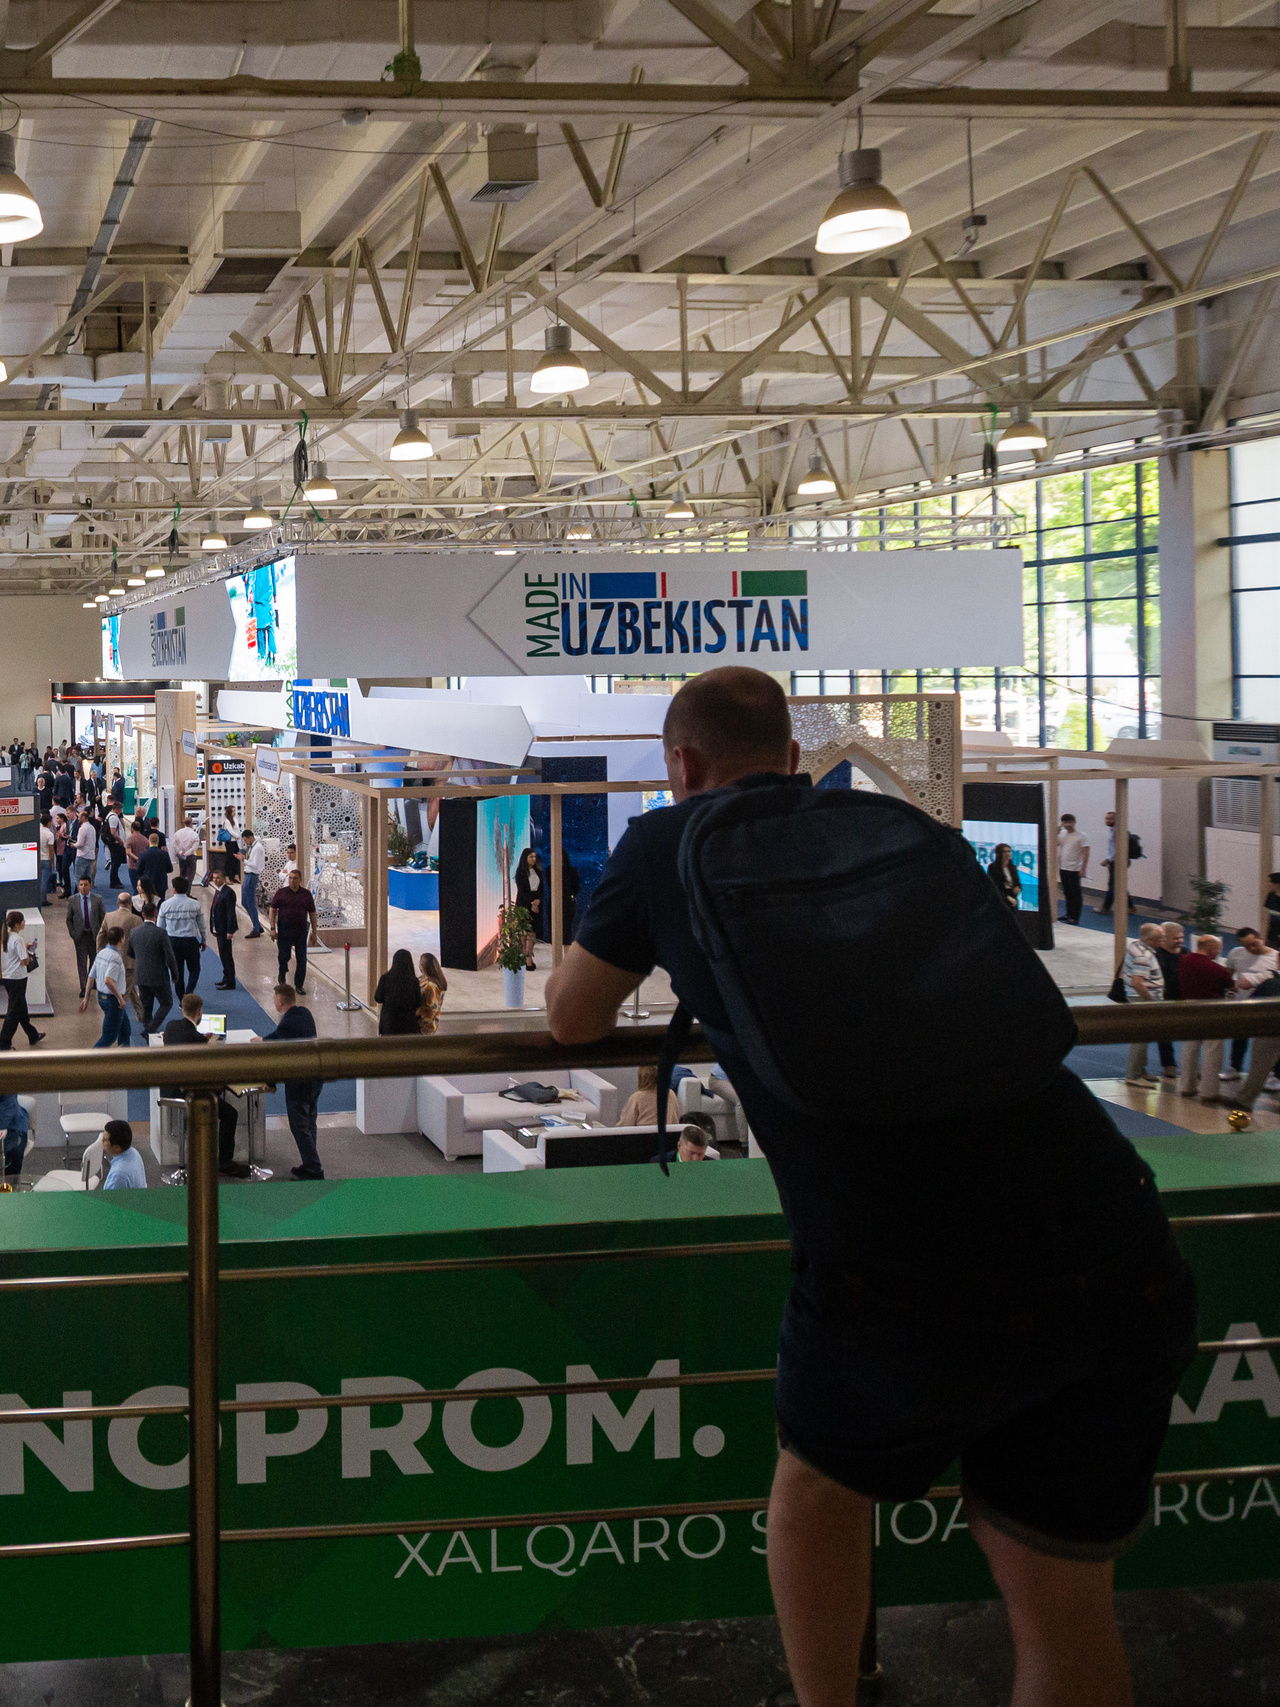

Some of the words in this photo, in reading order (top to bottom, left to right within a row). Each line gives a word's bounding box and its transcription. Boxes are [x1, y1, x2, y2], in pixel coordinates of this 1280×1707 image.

[562, 572, 587, 600] IN
[525, 572, 560, 658] MADE
[561, 599, 808, 657] UZBEKISTAN
[286, 680, 294, 728] MAD
[223, 762, 246, 770] Uzkab
[393, 1513, 727, 1577] XALQARO
